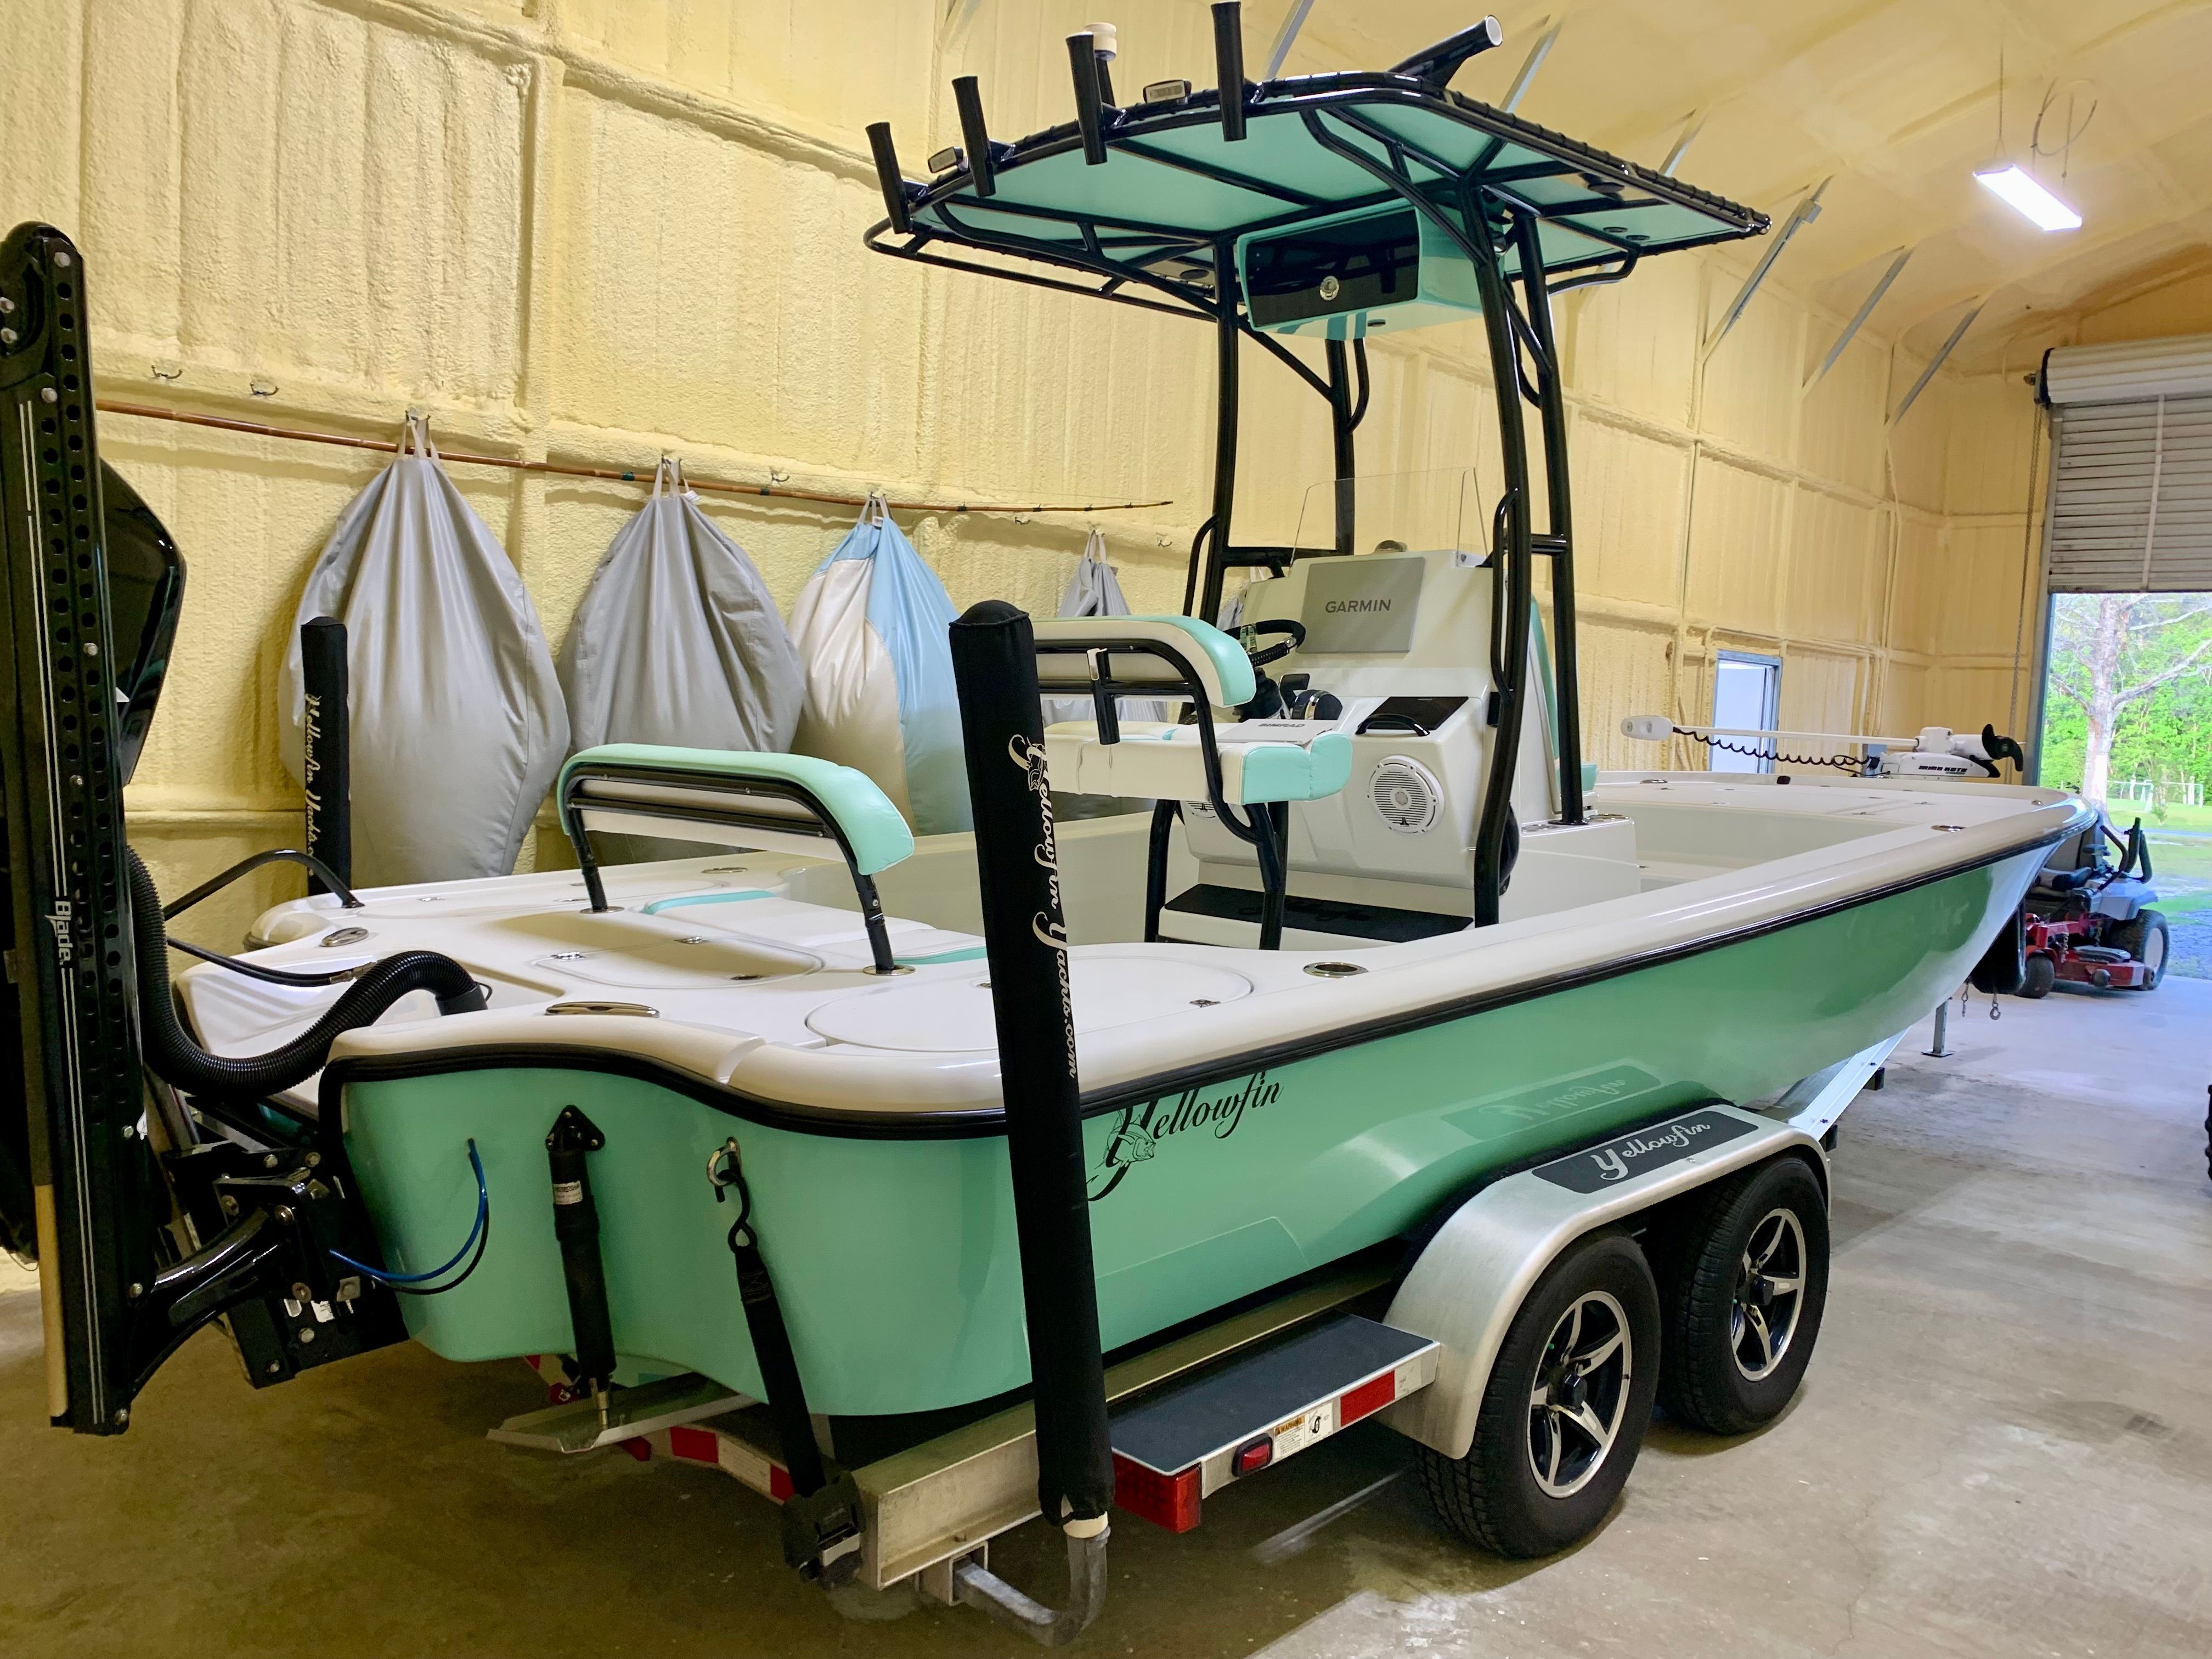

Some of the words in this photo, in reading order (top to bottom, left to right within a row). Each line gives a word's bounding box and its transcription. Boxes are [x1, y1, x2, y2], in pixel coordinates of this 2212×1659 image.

[1325, 599, 1391, 613] GARMIN
[44, 900, 73, 962] Blade
[1032, 911, 1078, 1079] Yachts.com
[1086, 1070, 1284, 1201] Yellowfin
[1590, 1124, 1711, 1181] Yellowfin
